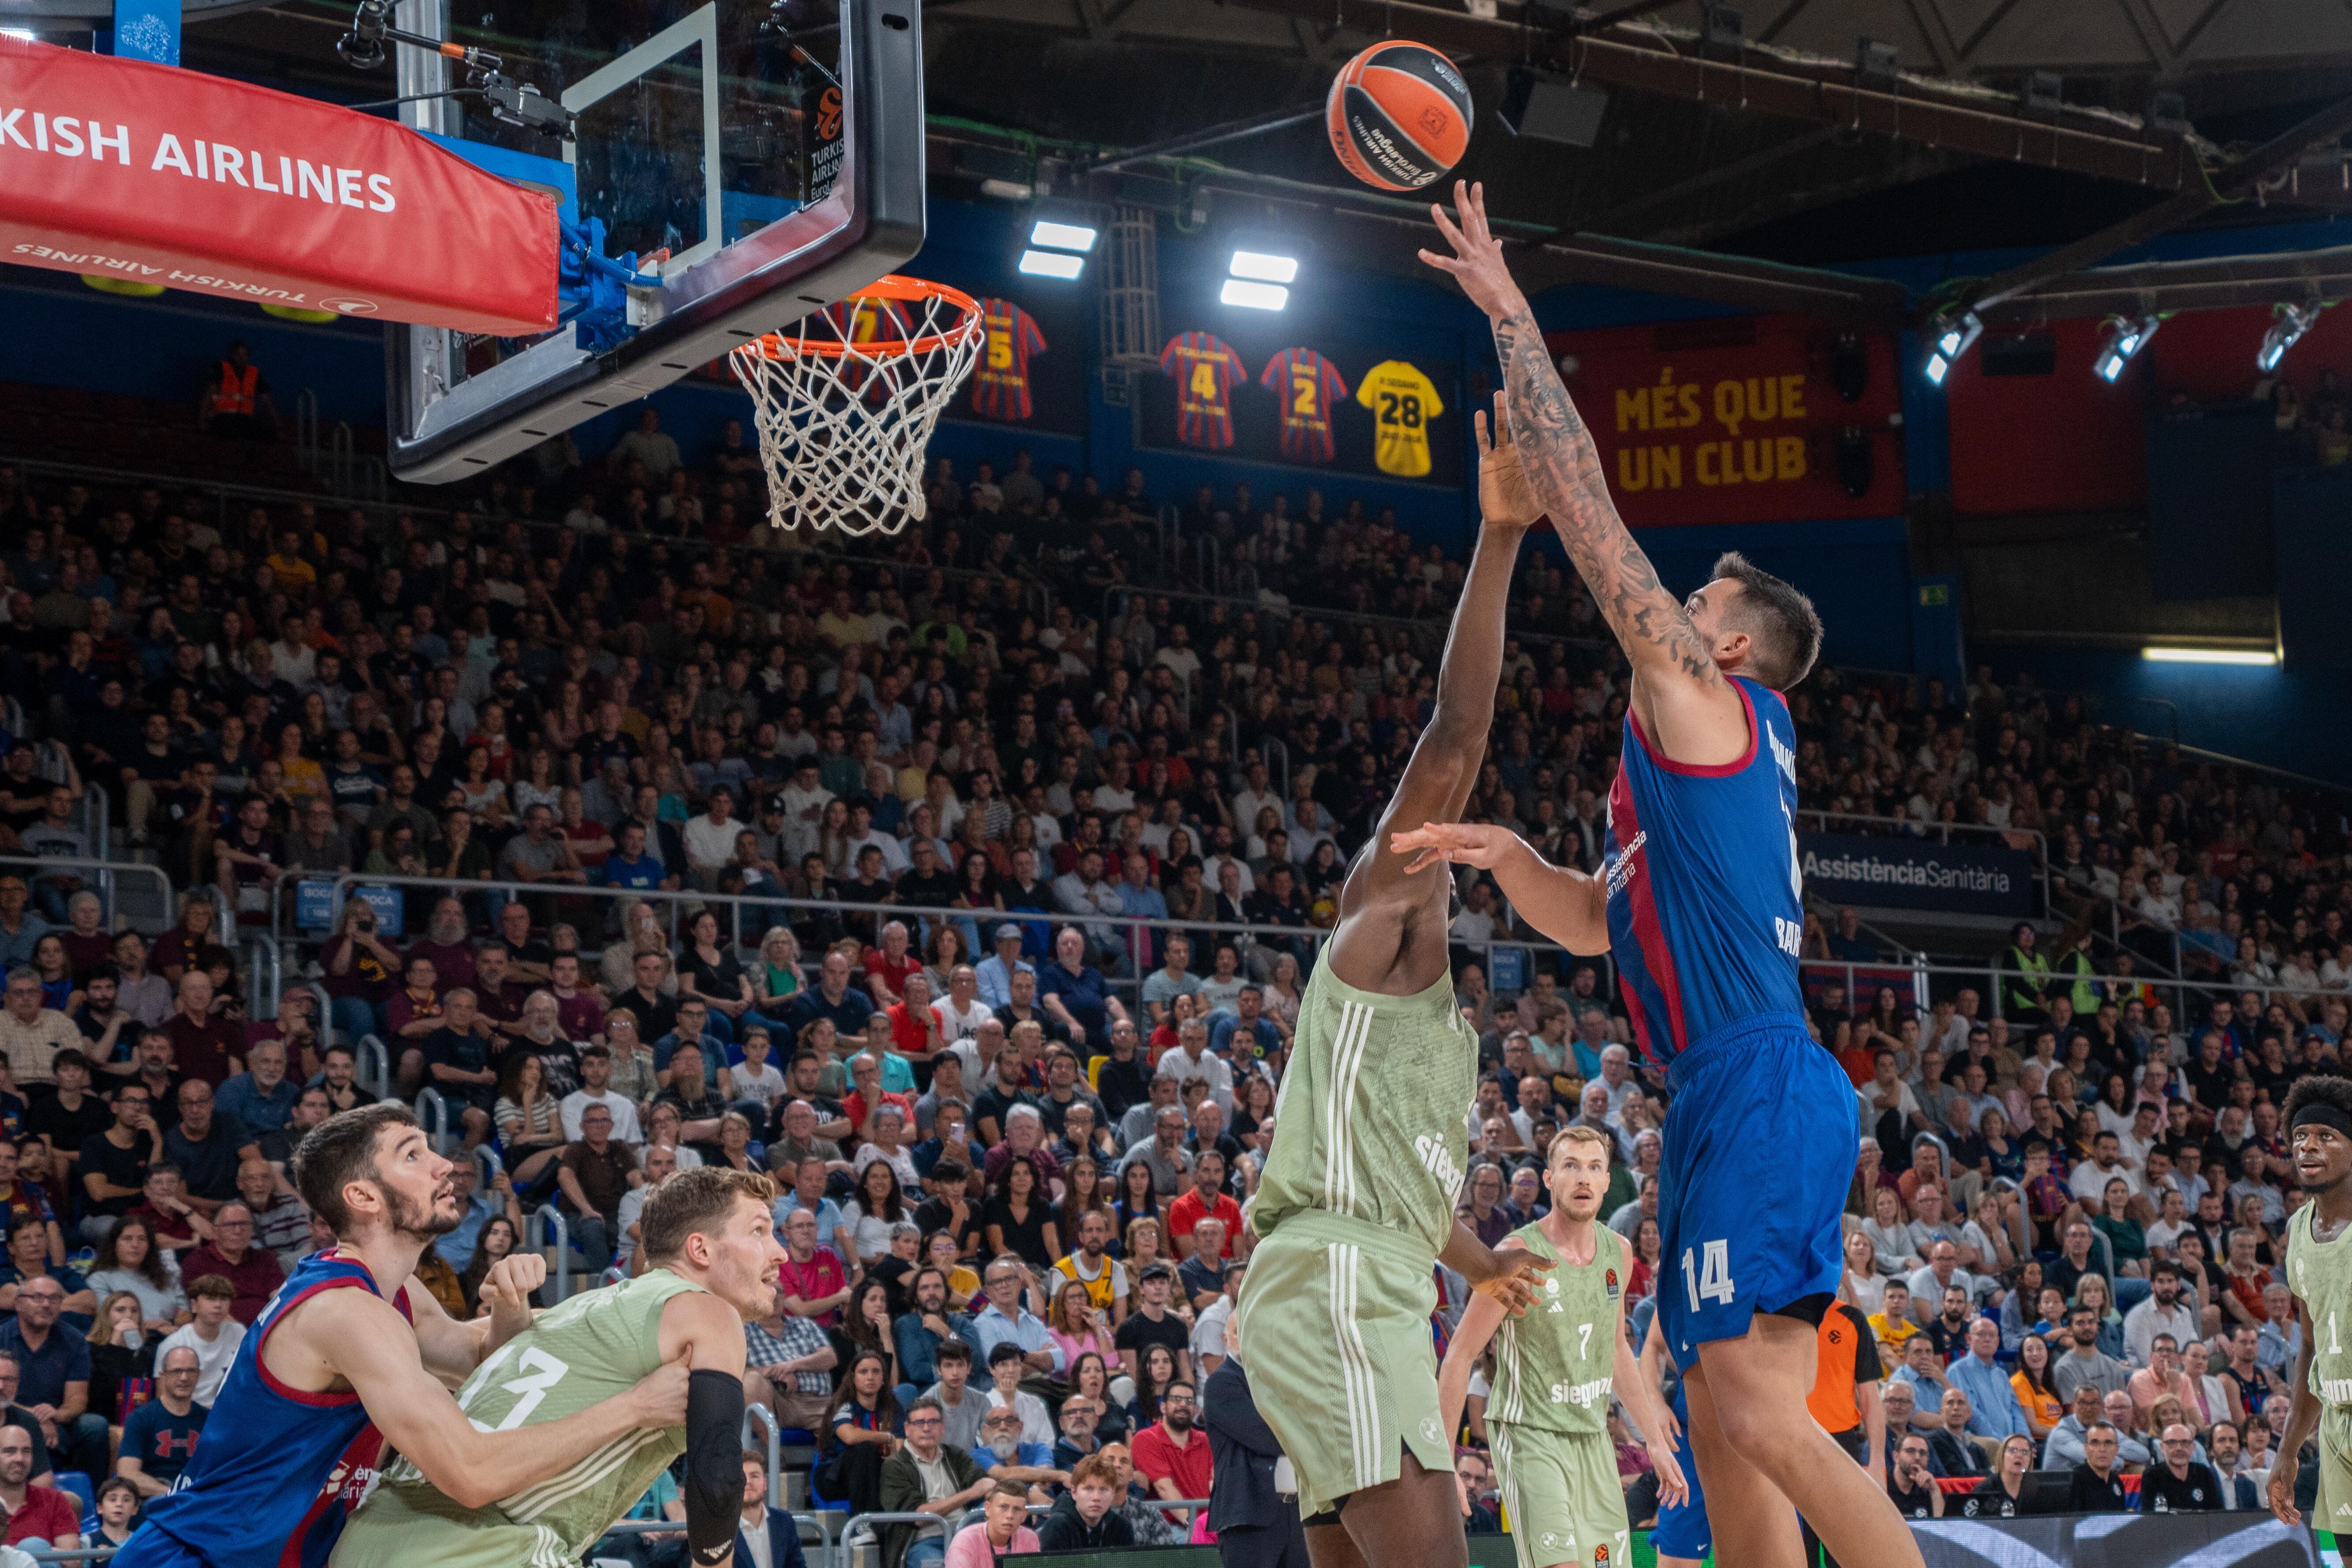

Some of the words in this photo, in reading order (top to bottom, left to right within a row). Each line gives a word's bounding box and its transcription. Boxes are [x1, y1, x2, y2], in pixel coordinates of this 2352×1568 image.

[811, 137, 844, 167] TURKIS
[1351, 115, 1382, 154] AIRLINES
[1371, 128, 1422, 176] EuroLeague
[0, 107, 131, 166] KISH
[151, 133, 396, 213] AIRLINES
[812, 155, 844, 186] AIRLIN
[1378, 154, 1412, 180] TURKISH
[811, 180, 834, 201] EuroL
[12, 243, 164, 276] AIRLINES
[168, 270, 306, 303] TURKISH
[988, 330, 1012, 369] 5
[1191, 363, 1216, 399] 4
[1293, 378, 1316, 414] 2
[1380, 390, 1420, 428] 28
[1616, 366, 1701, 432] MÉS
[1714, 374, 1806, 436] QUE
[1618, 445, 1682, 492] UN
[1695, 437, 1806, 486] CLUB
[1606, 830, 1647, 885] ssistència
[1775, 917, 1801, 958] BAR
[1415, 1132, 1465, 1202] sieg
[1103, 1276, 1111, 1293] 7
[1682, 1239, 1735, 1313] 14
[1578, 1323, 1593, 1361] 7
[2328, 1311, 2343, 1354] 1
[1614, 1529, 1627, 1566] 7
